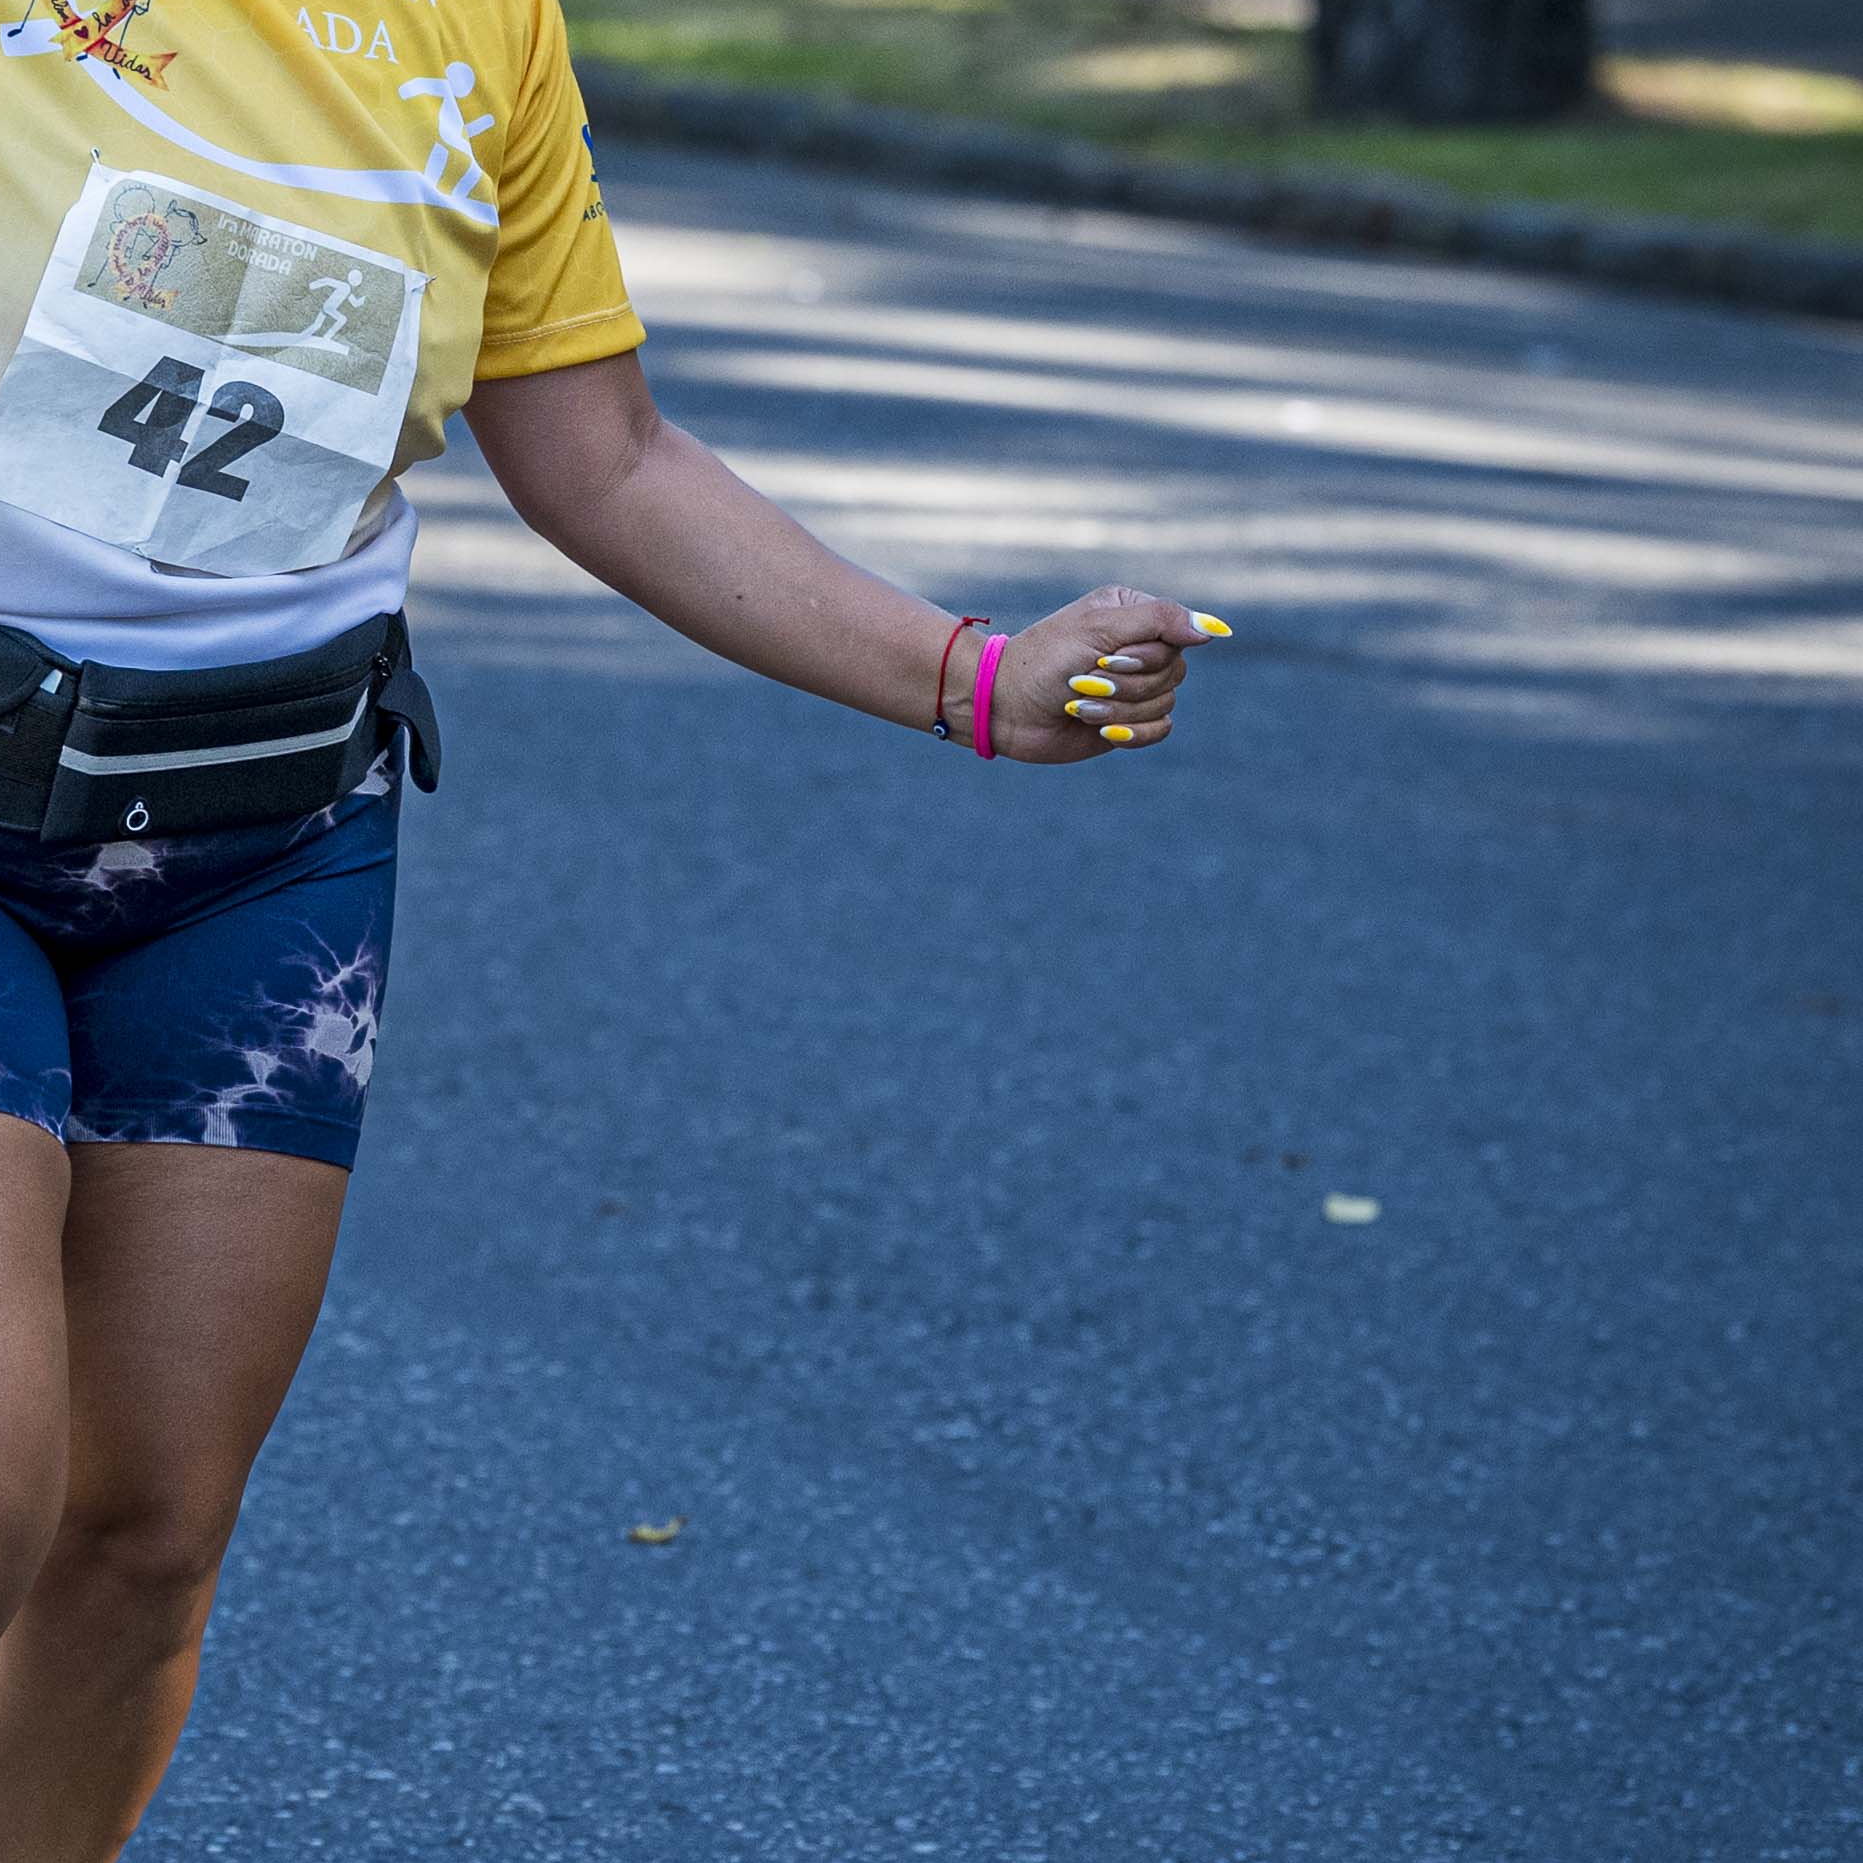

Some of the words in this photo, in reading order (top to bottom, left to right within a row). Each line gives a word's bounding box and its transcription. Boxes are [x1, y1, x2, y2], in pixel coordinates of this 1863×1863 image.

[296, 6, 400, 64] ADA
[228, 240, 292, 275] DORADA
[97, 356, 285, 502] 42
